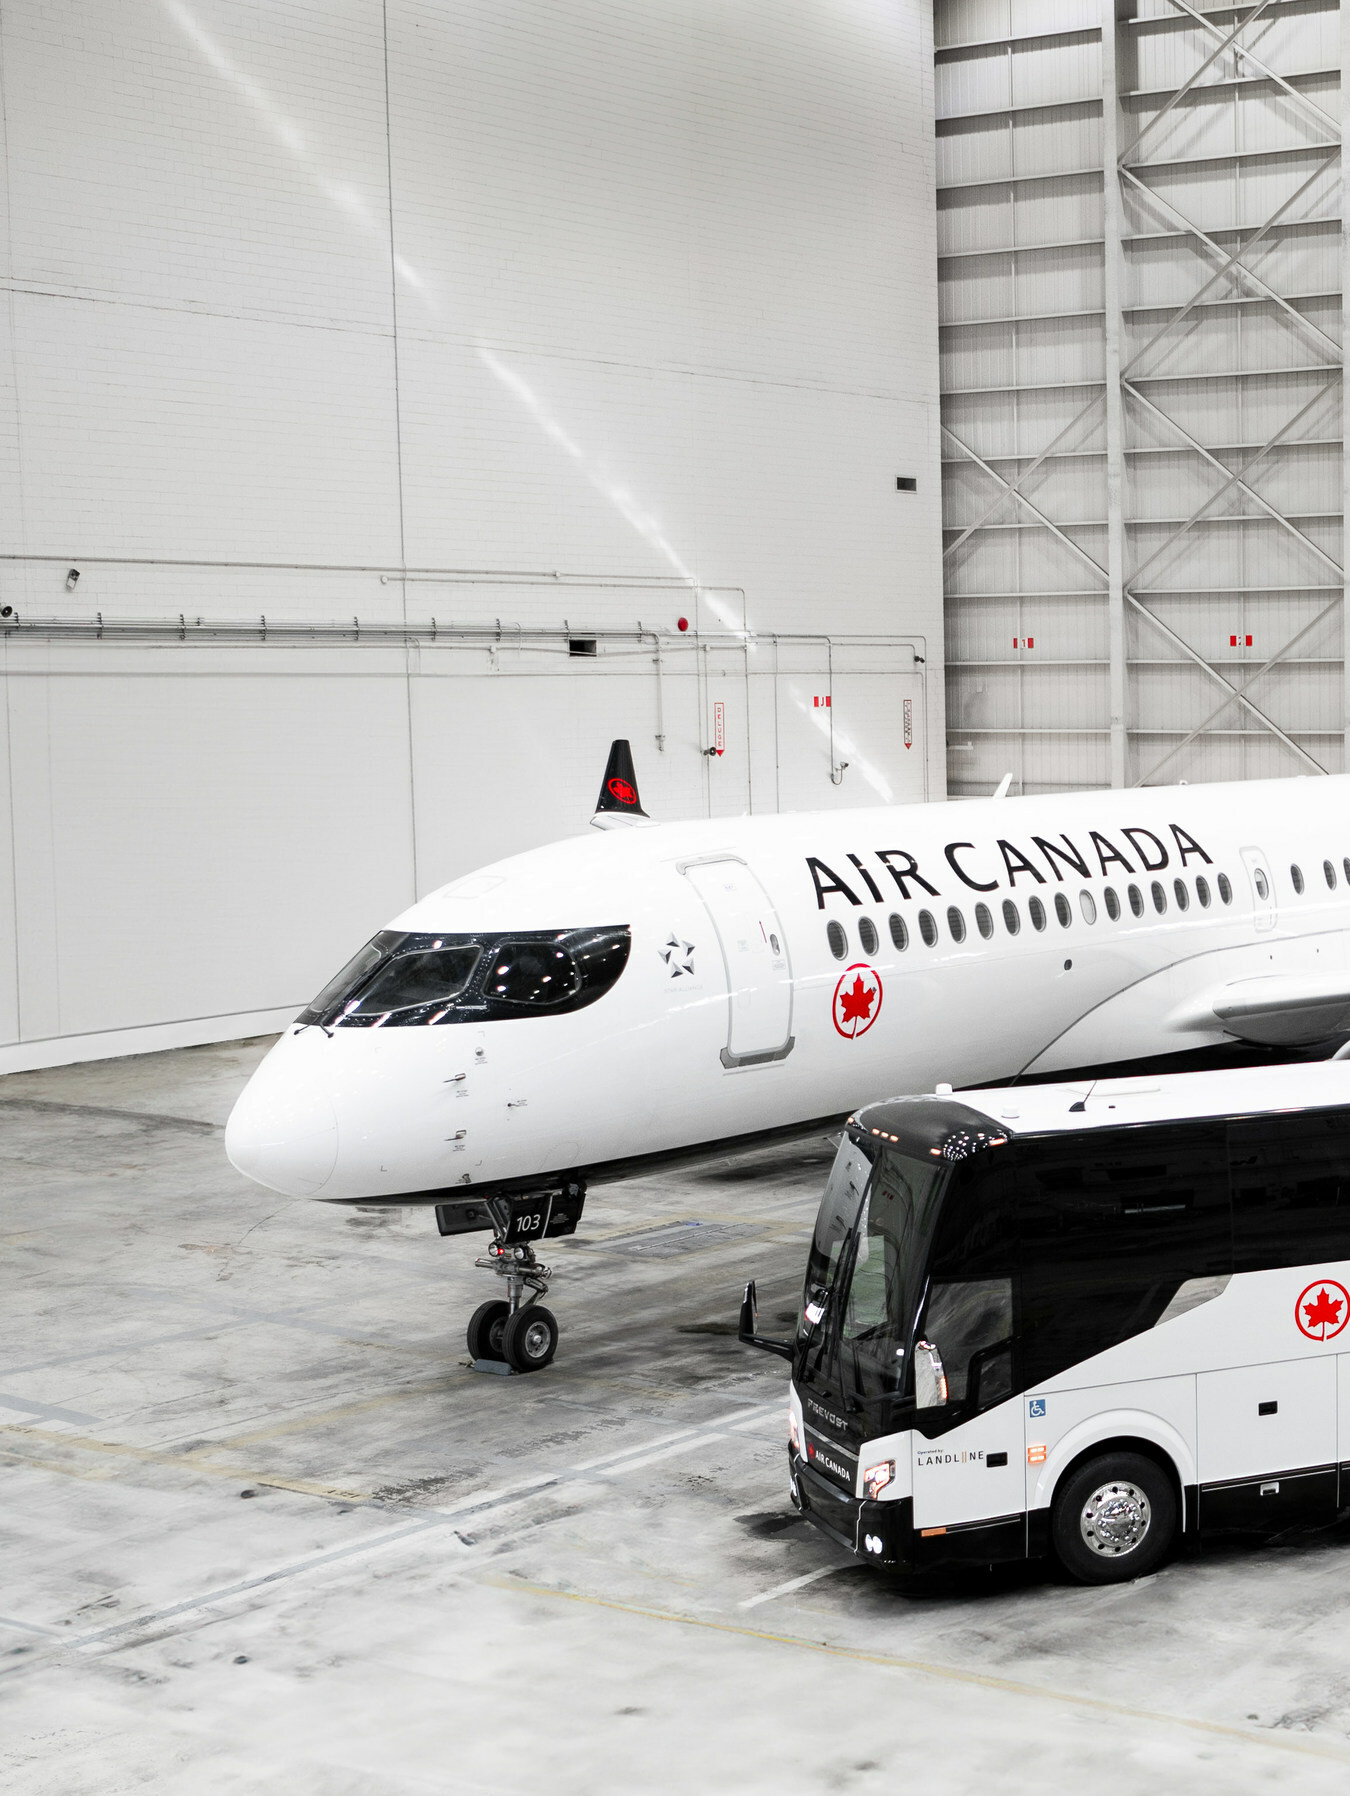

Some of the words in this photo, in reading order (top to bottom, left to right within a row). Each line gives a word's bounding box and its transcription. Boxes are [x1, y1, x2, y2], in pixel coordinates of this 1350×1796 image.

[805, 850, 941, 909] AIR
[944, 823, 1213, 892] CANADA
[516, 1213, 541, 1232] 103
[807, 1398, 849, 1431] PREVOST
[815, 1451, 825, 1466] AIR
[825, 1456, 851, 1481] CANADA
